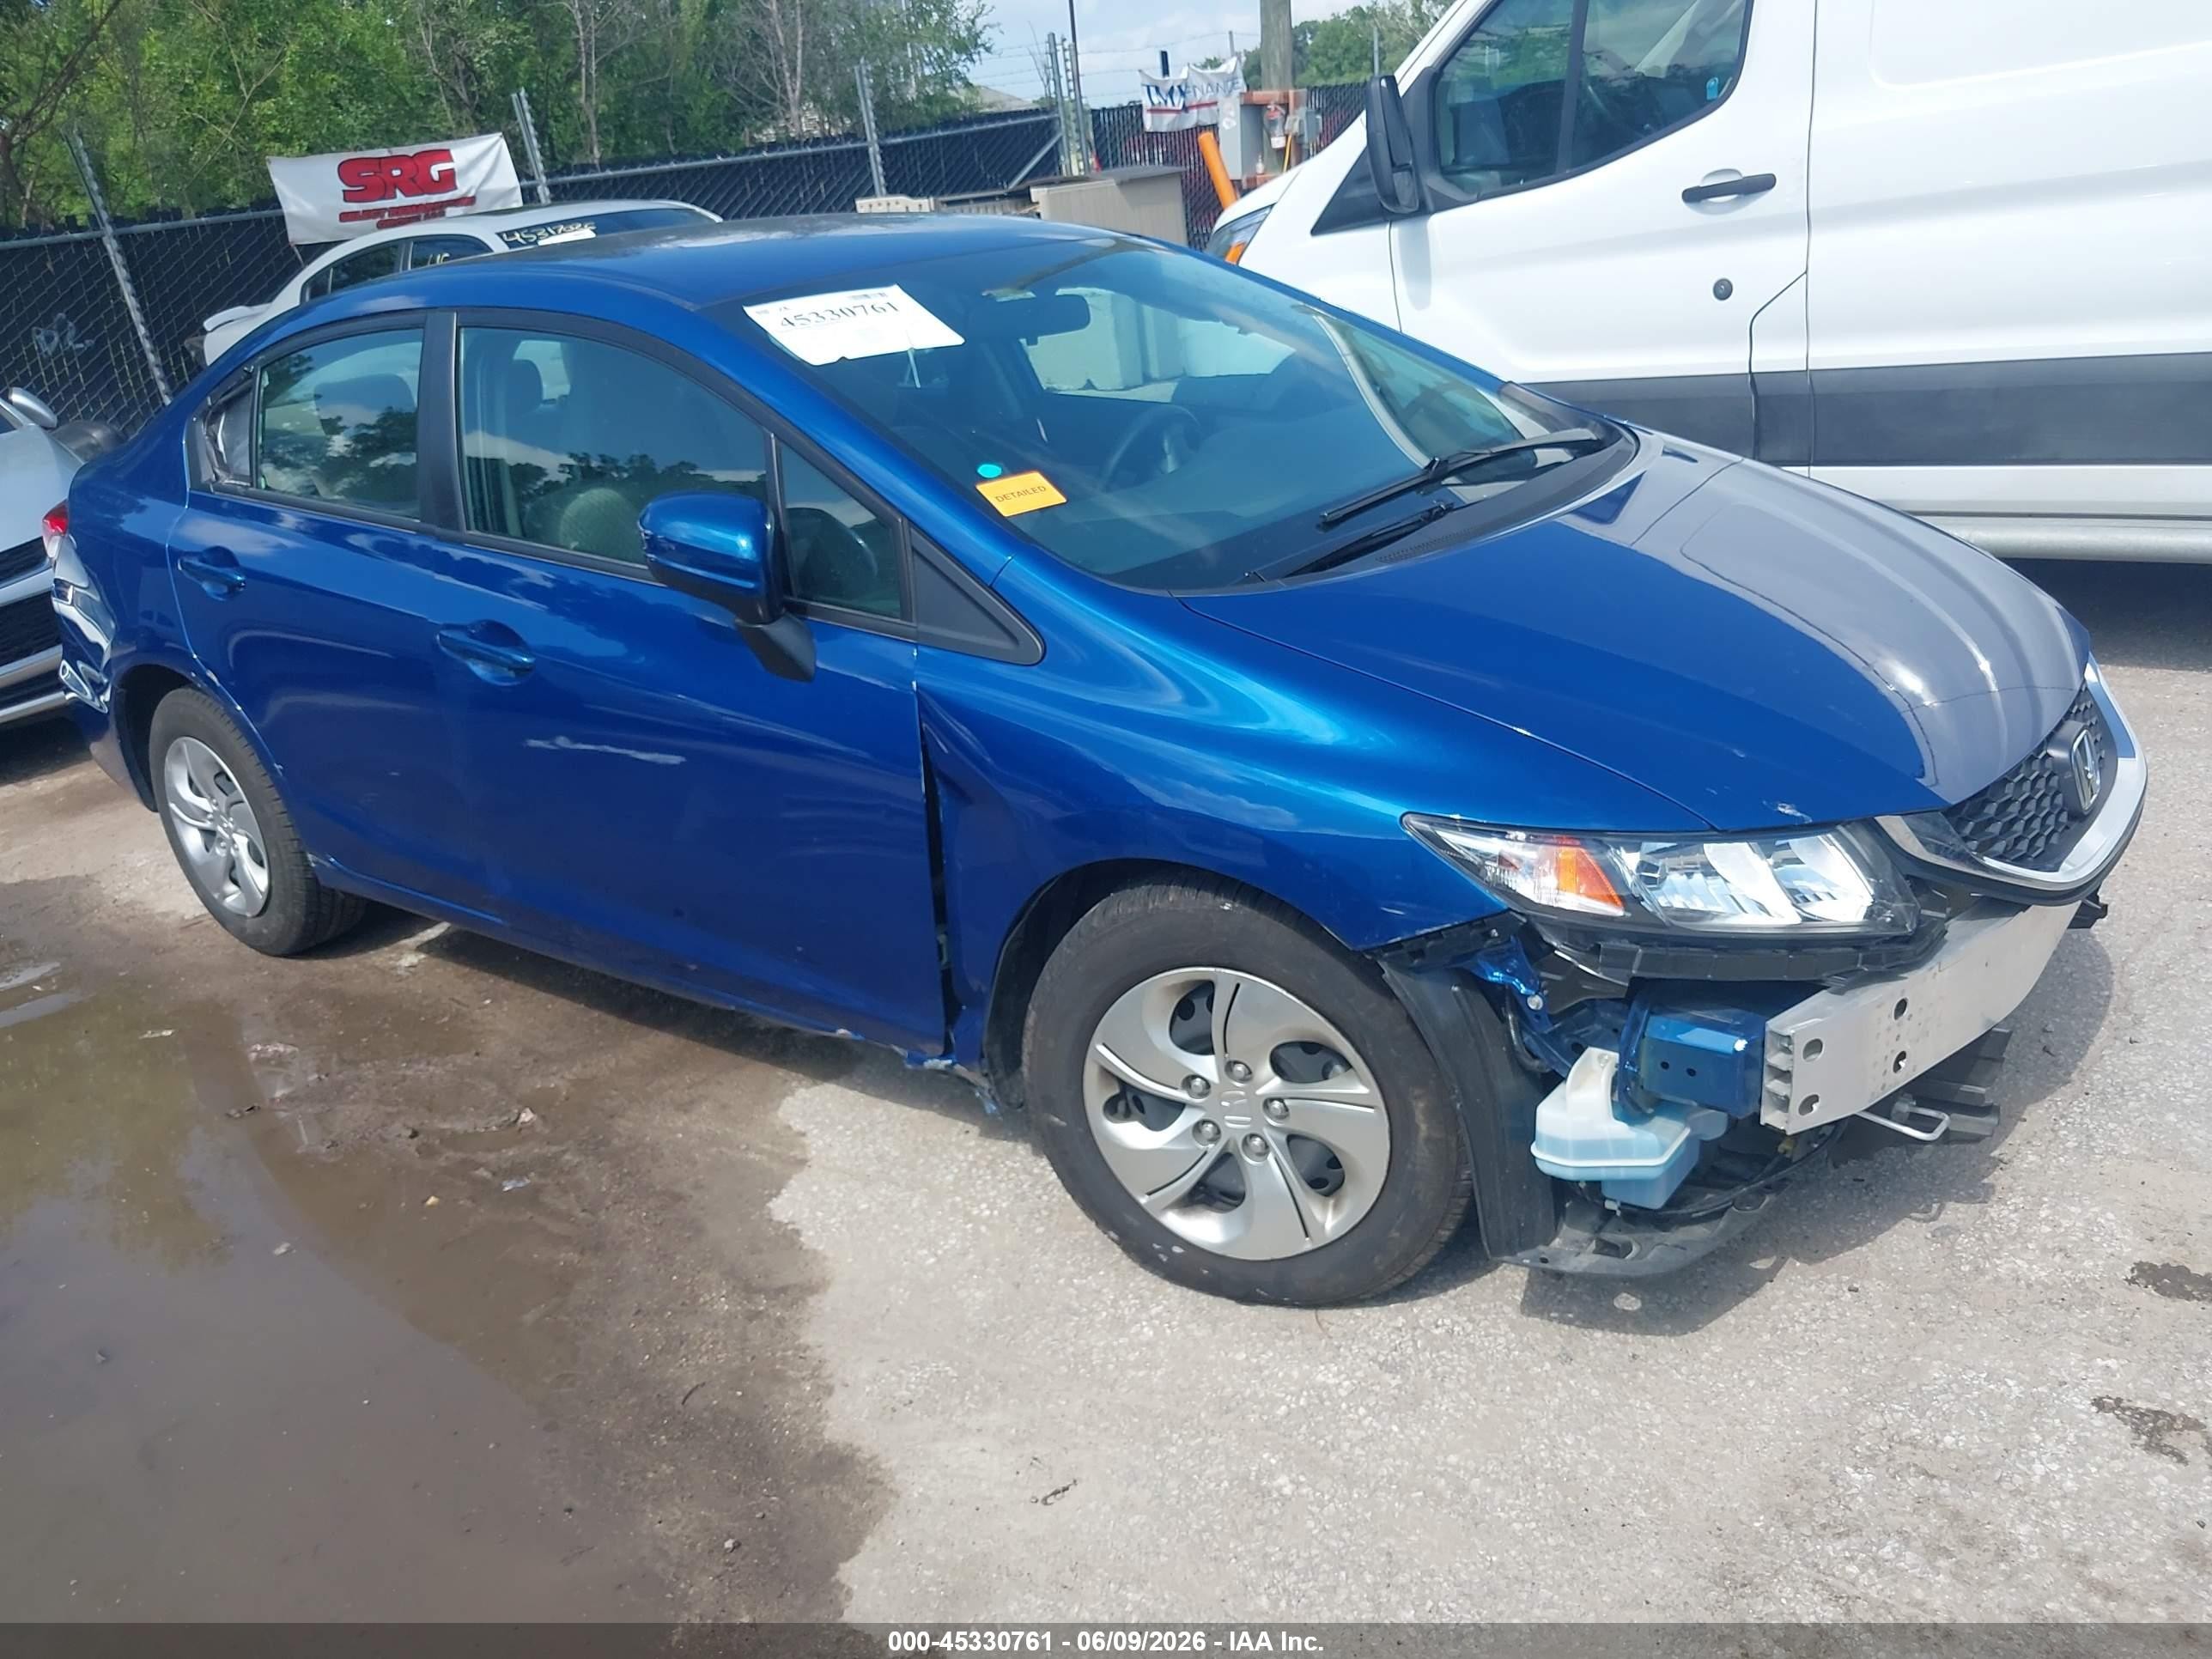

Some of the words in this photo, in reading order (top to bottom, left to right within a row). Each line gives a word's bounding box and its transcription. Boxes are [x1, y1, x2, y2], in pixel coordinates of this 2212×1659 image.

[337, 149, 458, 203] SRG
[781, 301, 900, 328] 45330761
[995, 485, 1047, 502] DETAILED
